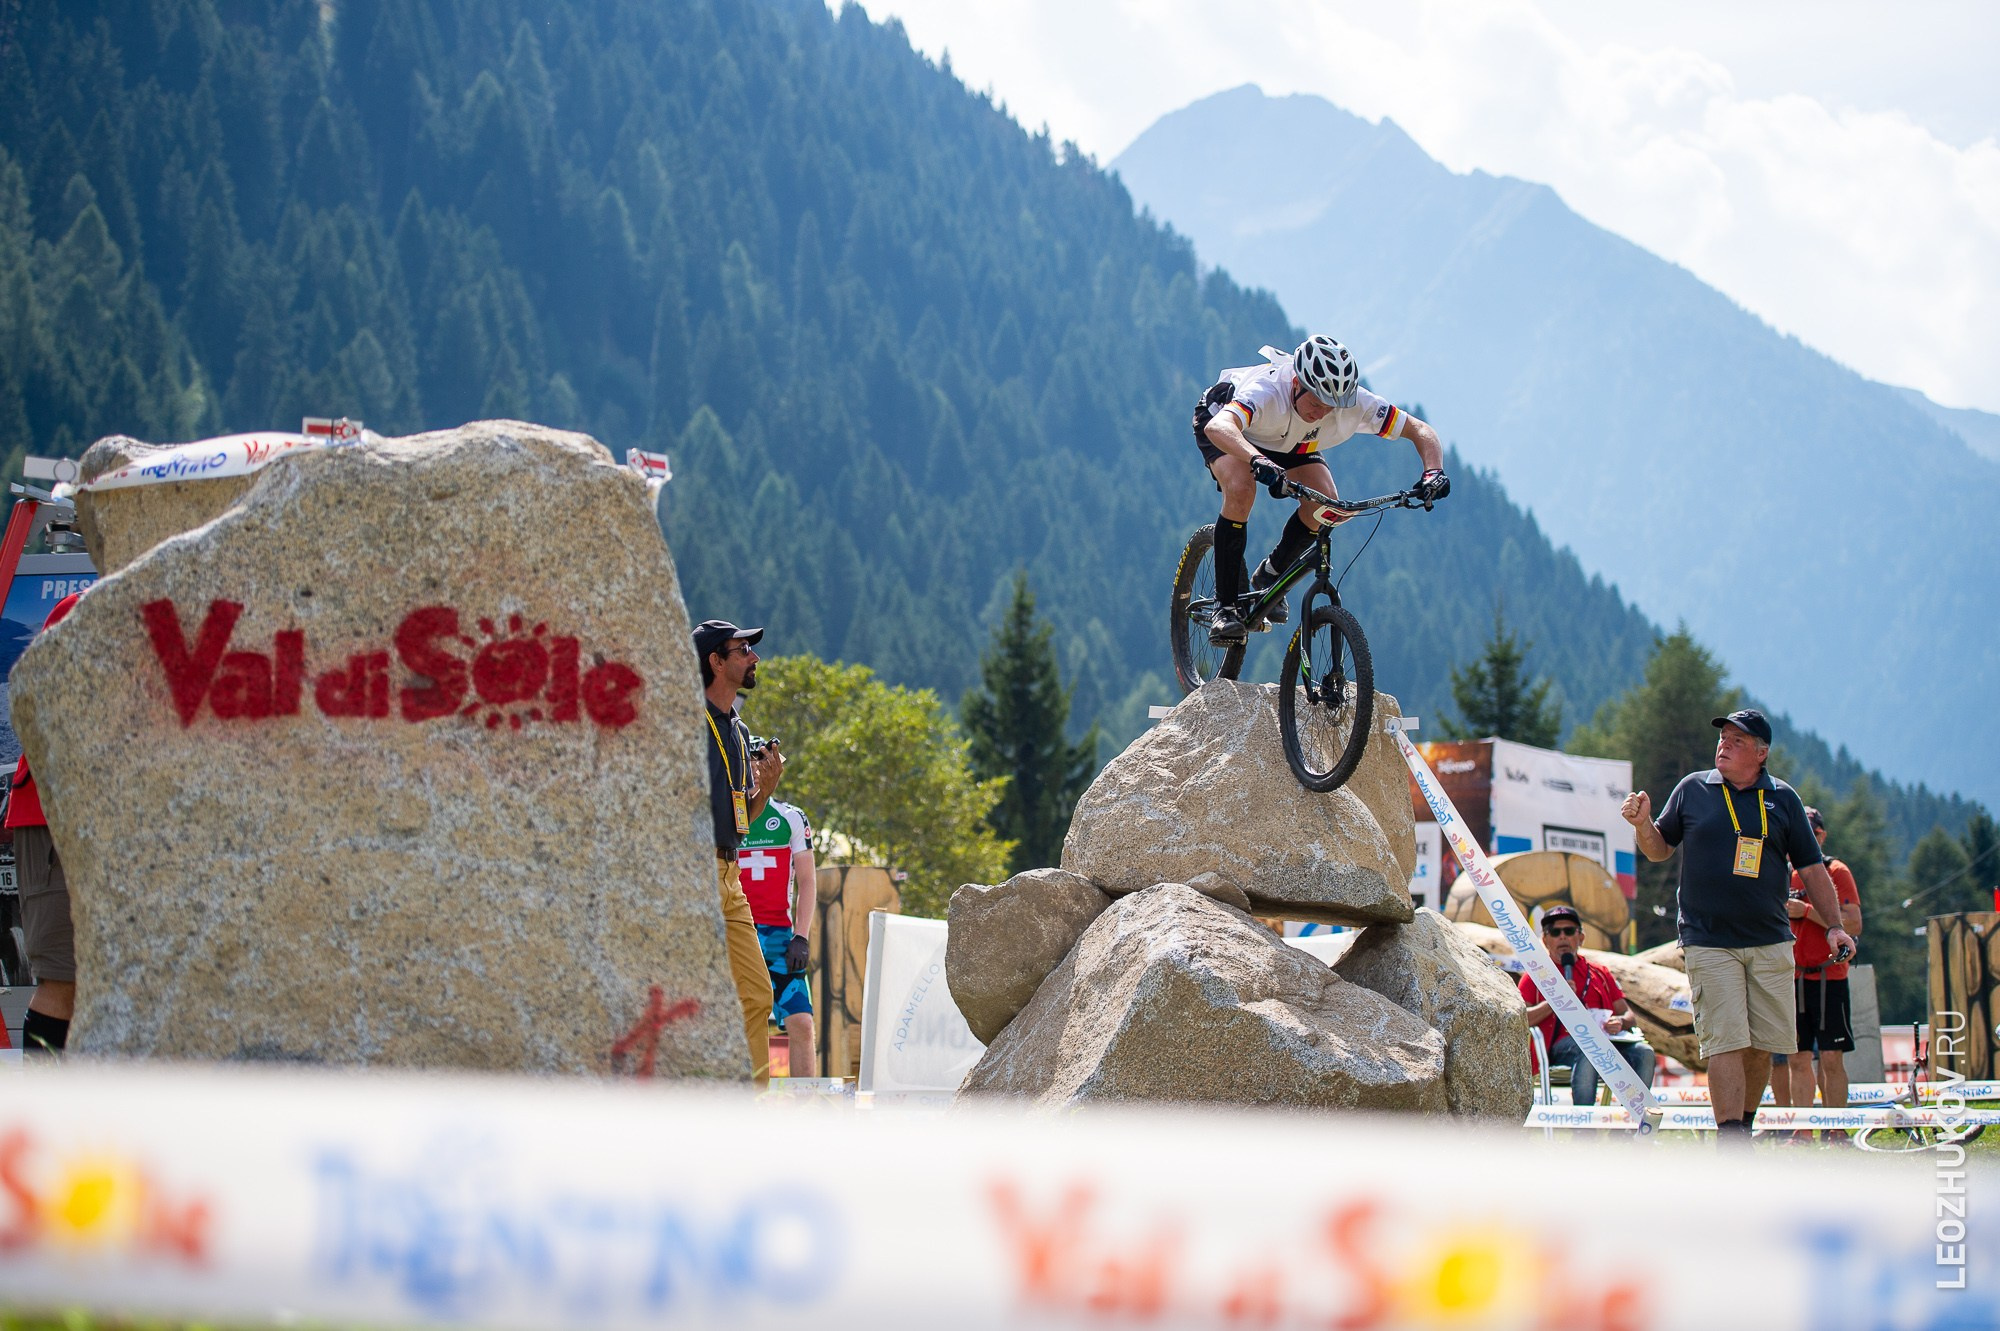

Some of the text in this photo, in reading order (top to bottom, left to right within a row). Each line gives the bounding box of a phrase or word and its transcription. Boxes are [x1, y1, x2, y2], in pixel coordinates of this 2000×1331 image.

[142, 598, 642, 729] Val di Sole
[893, 963, 941, 1052] ADAMELLO
[1848, 1089, 1884, 1101] ENTINO
